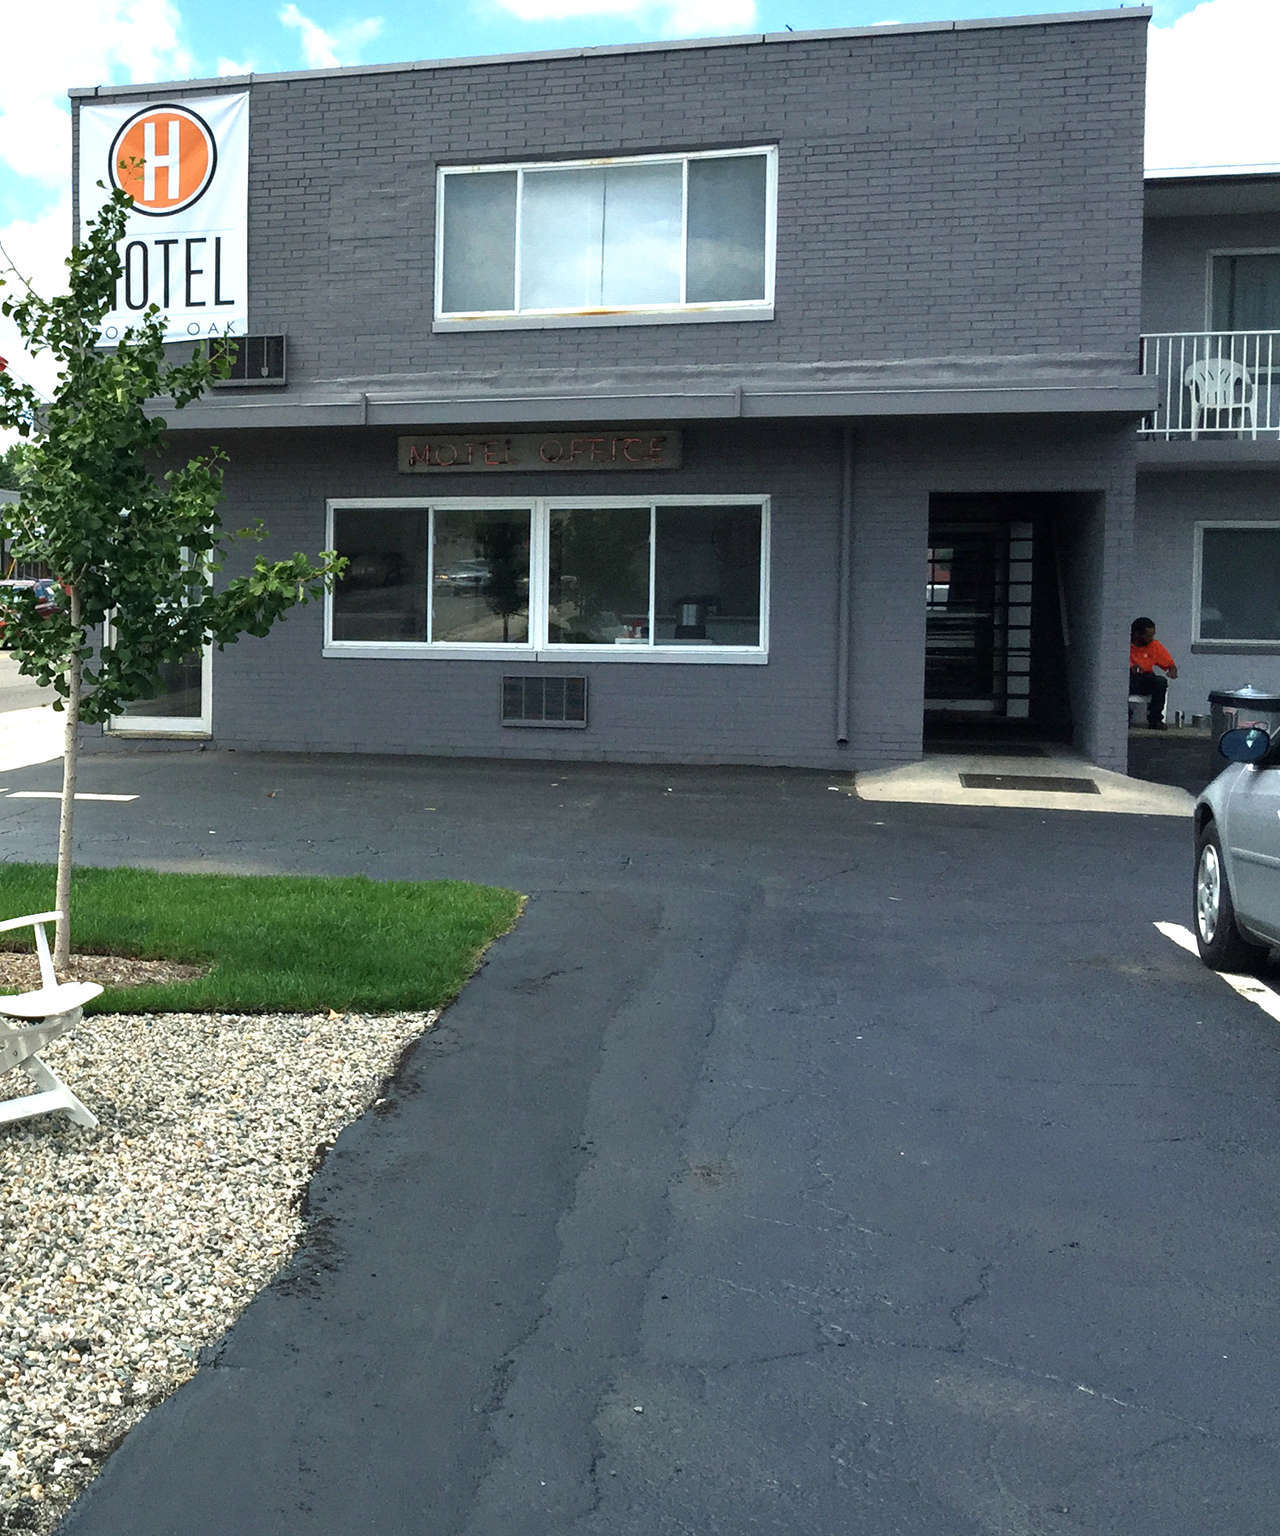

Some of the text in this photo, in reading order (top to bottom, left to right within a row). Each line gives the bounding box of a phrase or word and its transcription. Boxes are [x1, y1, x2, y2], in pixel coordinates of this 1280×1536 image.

[143, 120, 180, 201] H
[187, 320, 236, 336] OAK
[408, 436, 666, 467] MOTEL OFFICE
